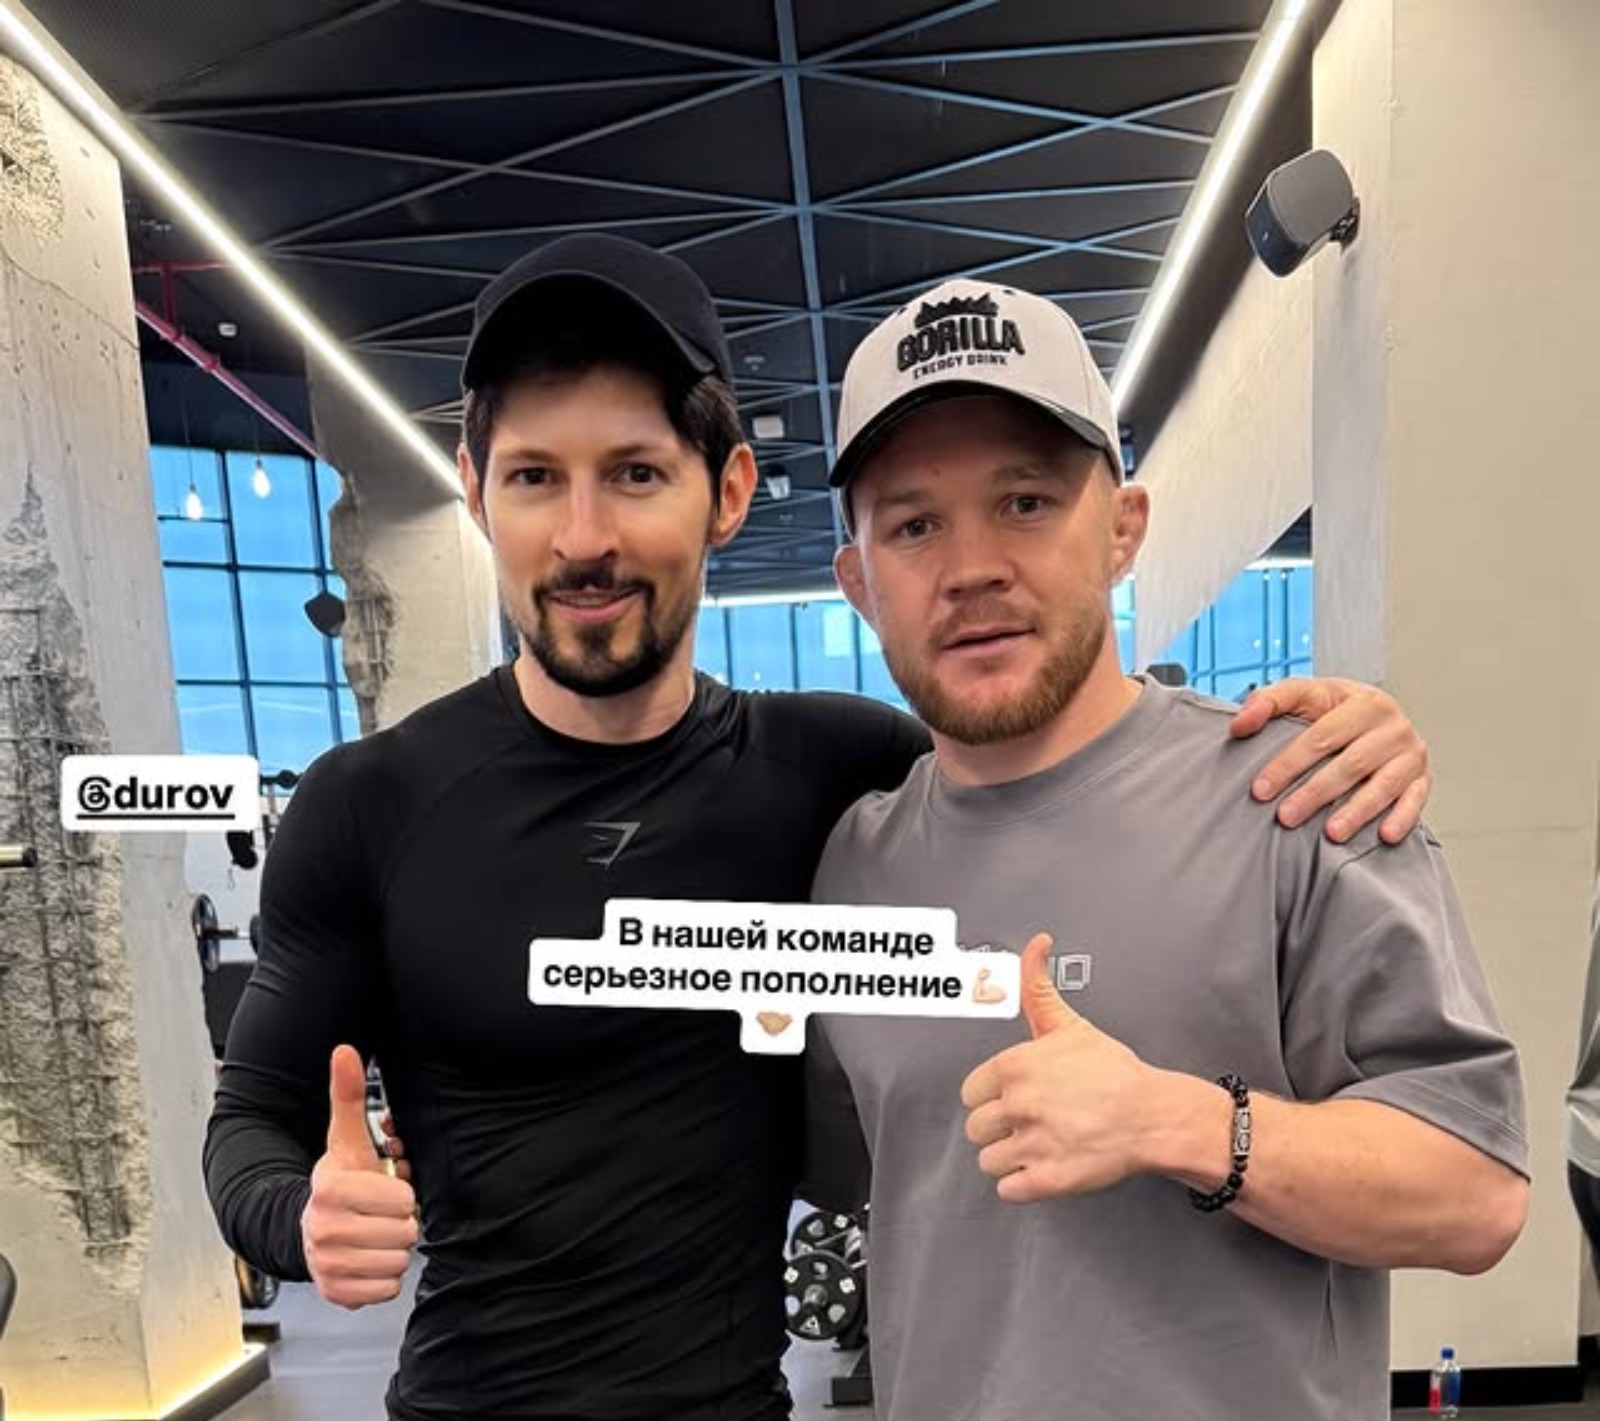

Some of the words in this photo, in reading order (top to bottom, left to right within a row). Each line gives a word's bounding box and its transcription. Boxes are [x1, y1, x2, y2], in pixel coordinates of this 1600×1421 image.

[897, 316, 1025, 373] GORILLA
[913, 354, 962, 380] ENERGY
[966, 352, 1008, 367] DRINK
